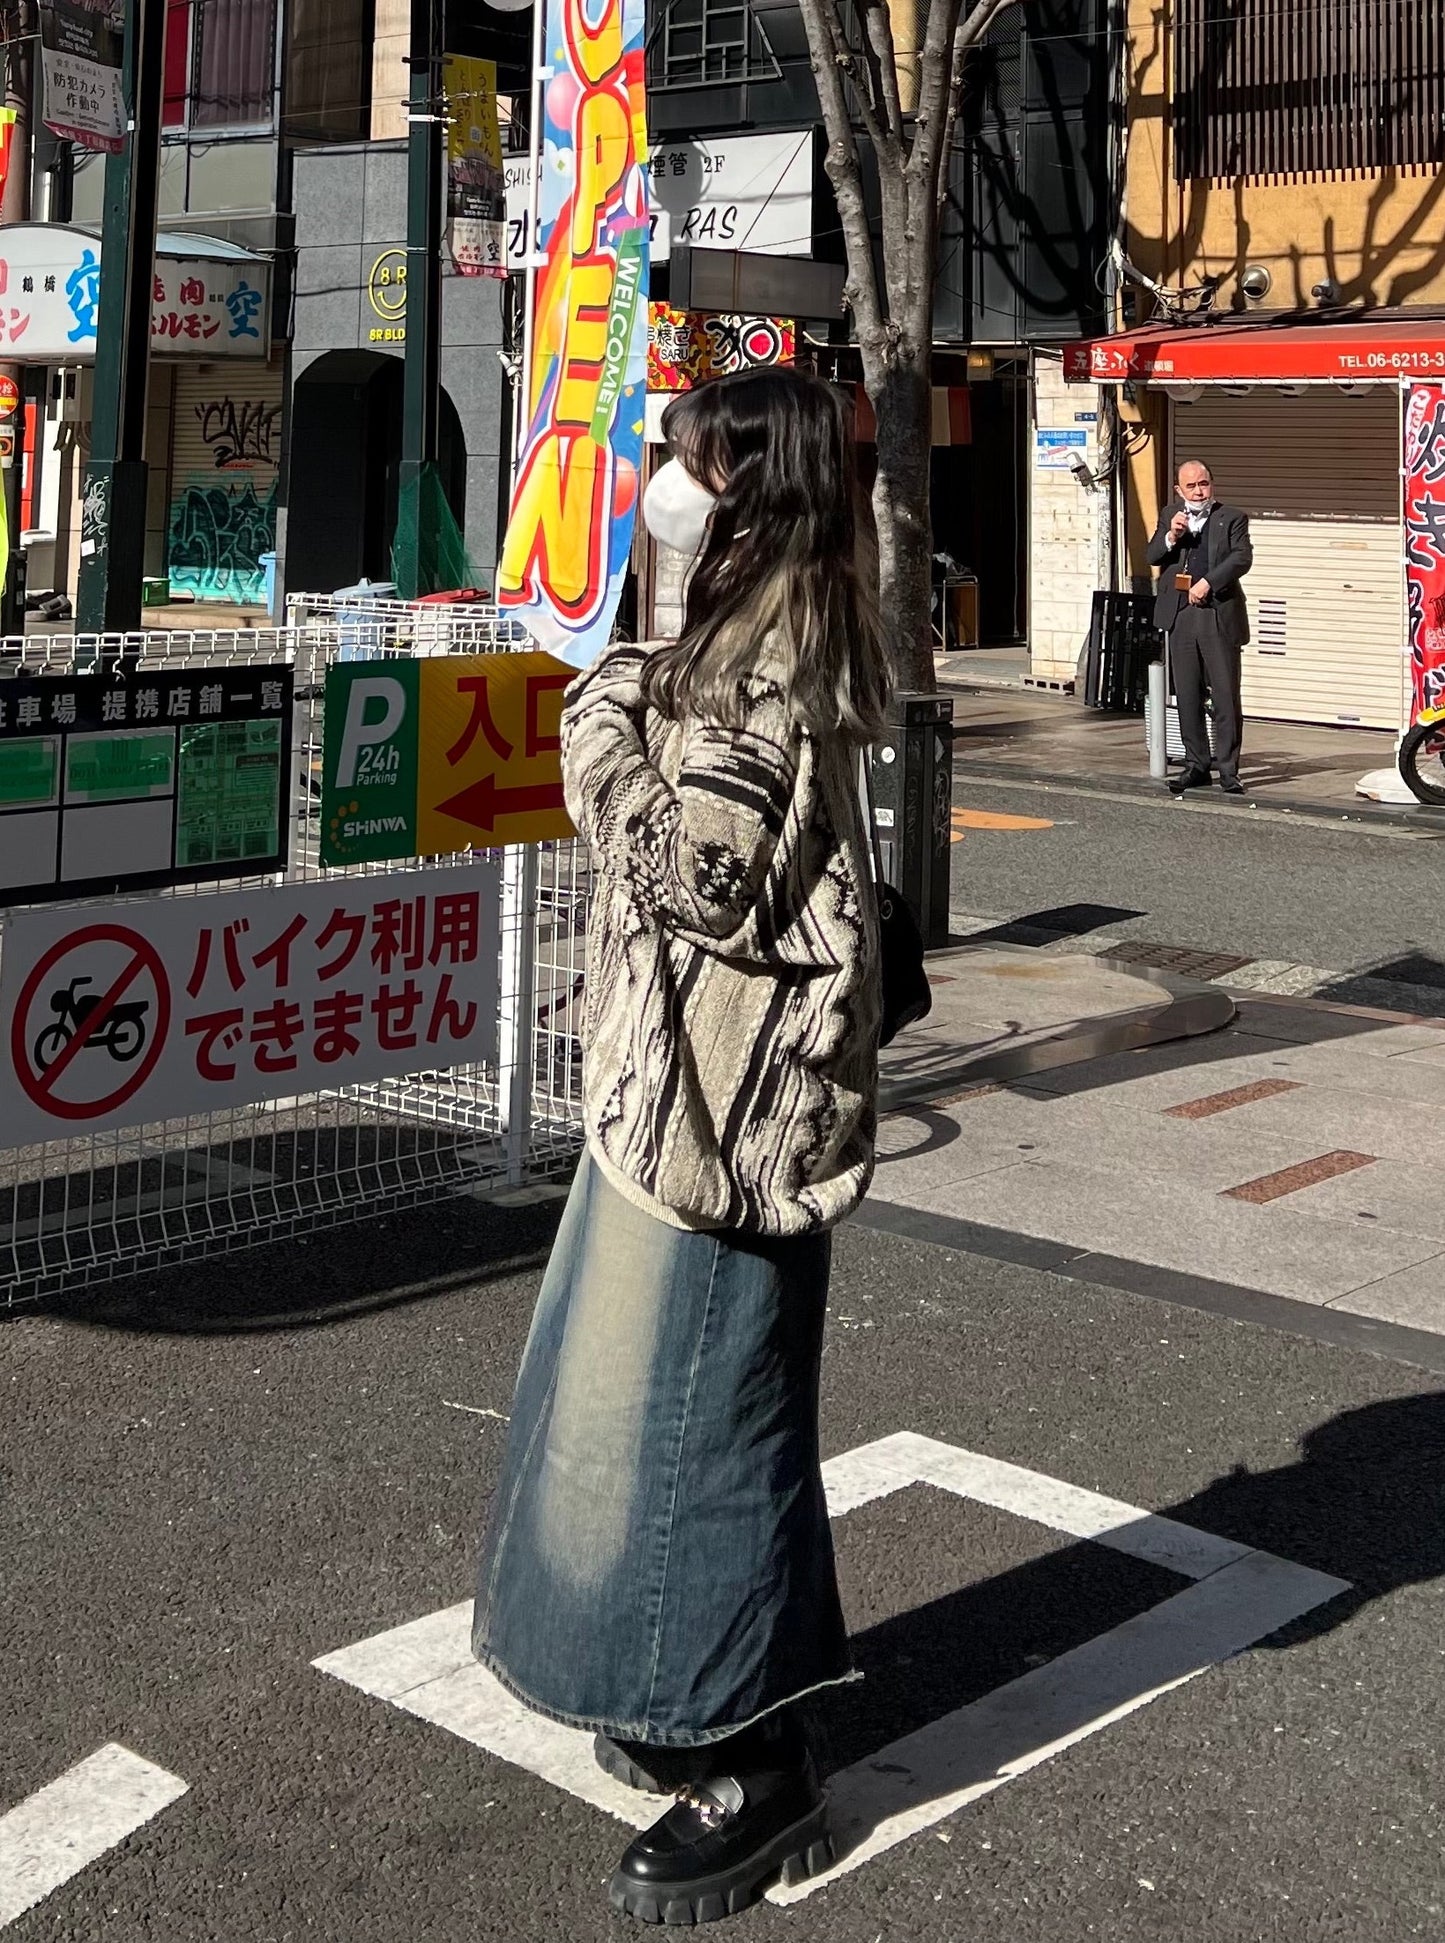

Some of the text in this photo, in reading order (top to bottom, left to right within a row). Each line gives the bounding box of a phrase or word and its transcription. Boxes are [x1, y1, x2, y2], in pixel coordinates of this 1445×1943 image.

[53, 72, 106, 99] 防犯カメラ
[66, 92, 99, 114] 作動中
[704, 155, 725, 173] 2F
[681, 205, 737, 240] RAS
[226, 281, 262, 338] 空
[660, 348, 689, 361] SARU
[0, 681, 284, 728] 車場 提携店舗一覧
[335, 676, 407, 788] P
[358, 745, 400, 773] 24h
[356, 773, 397, 786] Parking
[186, 891, 481, 999] バイク利用
[184, 973, 478, 1082] できません
